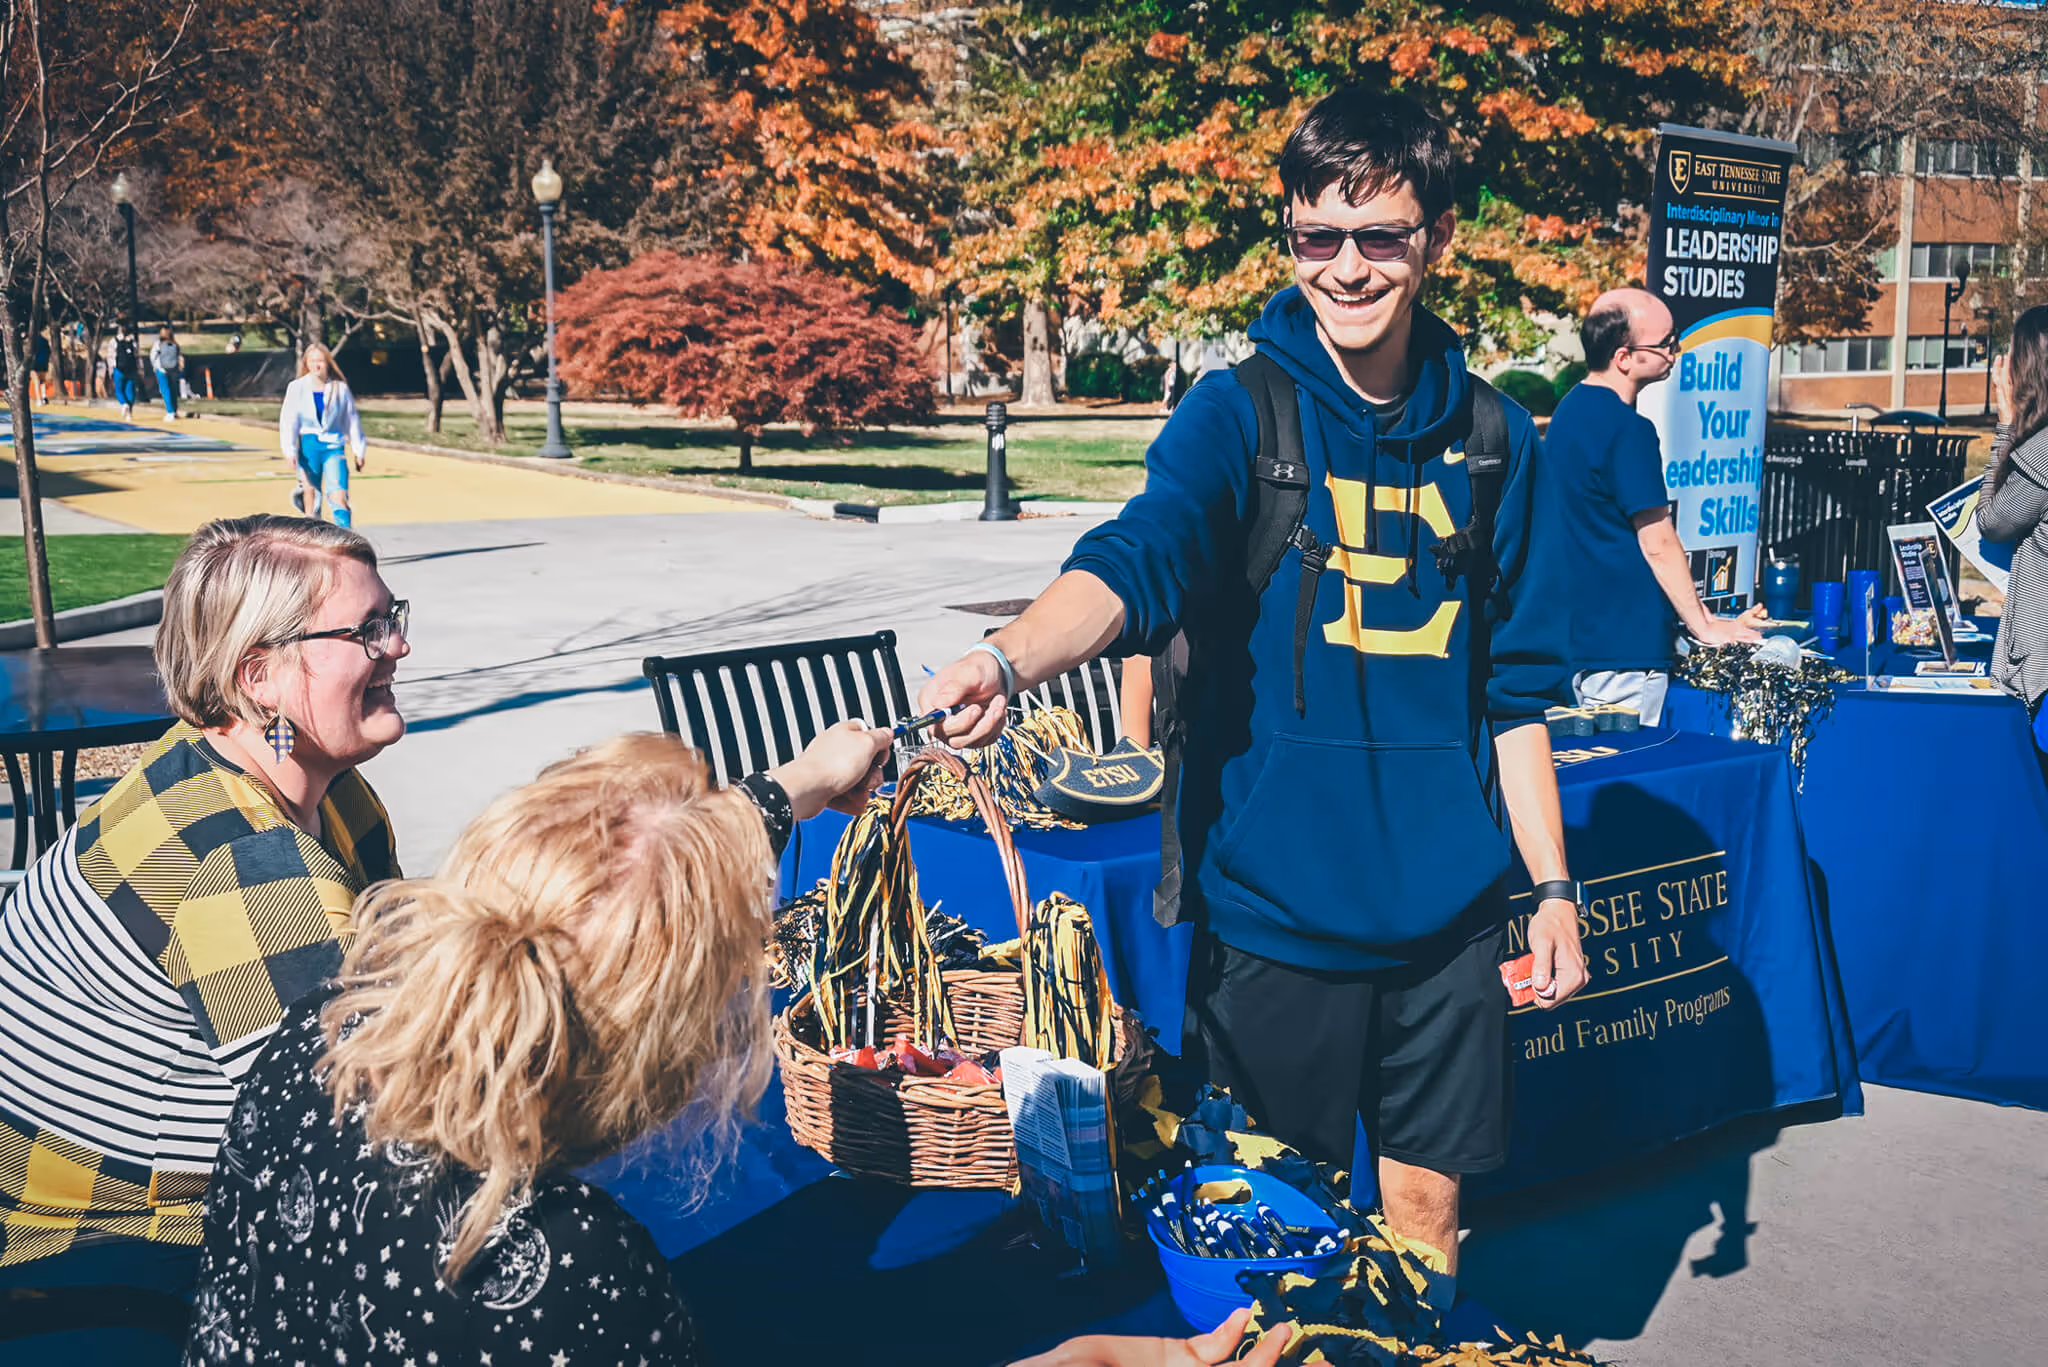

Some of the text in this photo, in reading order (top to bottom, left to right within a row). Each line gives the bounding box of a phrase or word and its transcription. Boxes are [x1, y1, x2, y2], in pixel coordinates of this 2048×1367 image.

[1674, 157, 1688, 182] E
[1695, 160, 1782, 185] EAST TENNESSEE STATE
[1711, 179, 1766, 195] UNIVERSITY
[1667, 202, 1780, 228] Interdisciplinary Minor in
[1665, 227, 1779, 265] LEADERSHIP
[1663, 265, 1746, 299] STUDIES
[1679, 351, 1743, 392] Build
[1698, 400, 1751, 440] Your
[1666, 445, 1763, 491] eadership
[1698, 495, 1758, 536] Skills
[1322, 471, 1461, 658] E
[1081, 764, 1141, 788] ETSU
[1656, 870, 1729, 921] STATE
[1524, 985, 1731, 1060] and Family Programs
